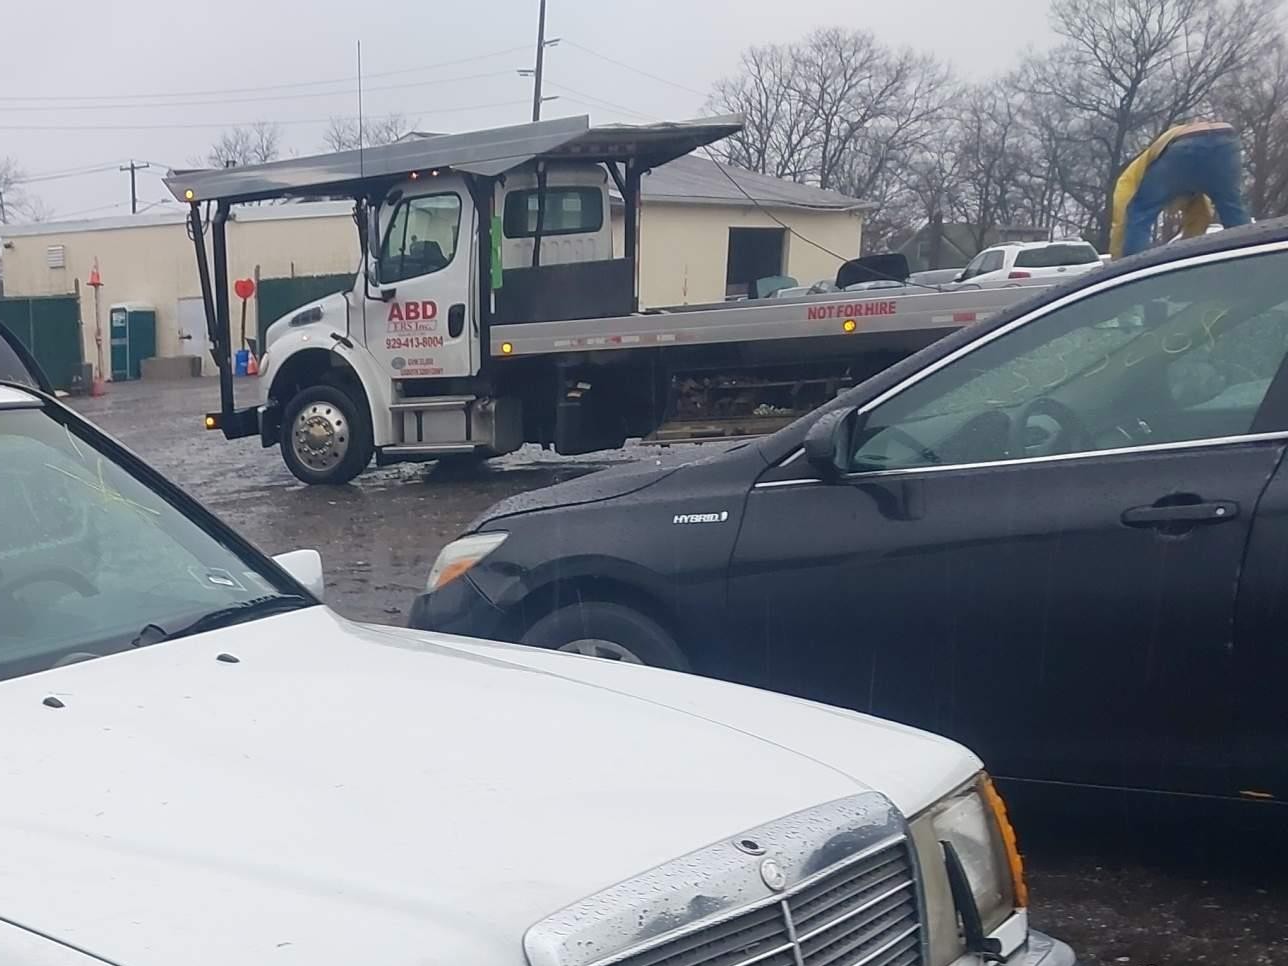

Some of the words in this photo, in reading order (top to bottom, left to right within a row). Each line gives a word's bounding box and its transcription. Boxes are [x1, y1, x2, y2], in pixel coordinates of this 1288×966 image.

[388, 300, 437, 321] ABD
[808, 306, 834, 320] NOT
[837, 303, 862, 317] FOR
[865, 301, 896, 315] HIRE
[386, 335, 443, 349] 929-413-8004
[673, 513, 720, 524] HYBRID
